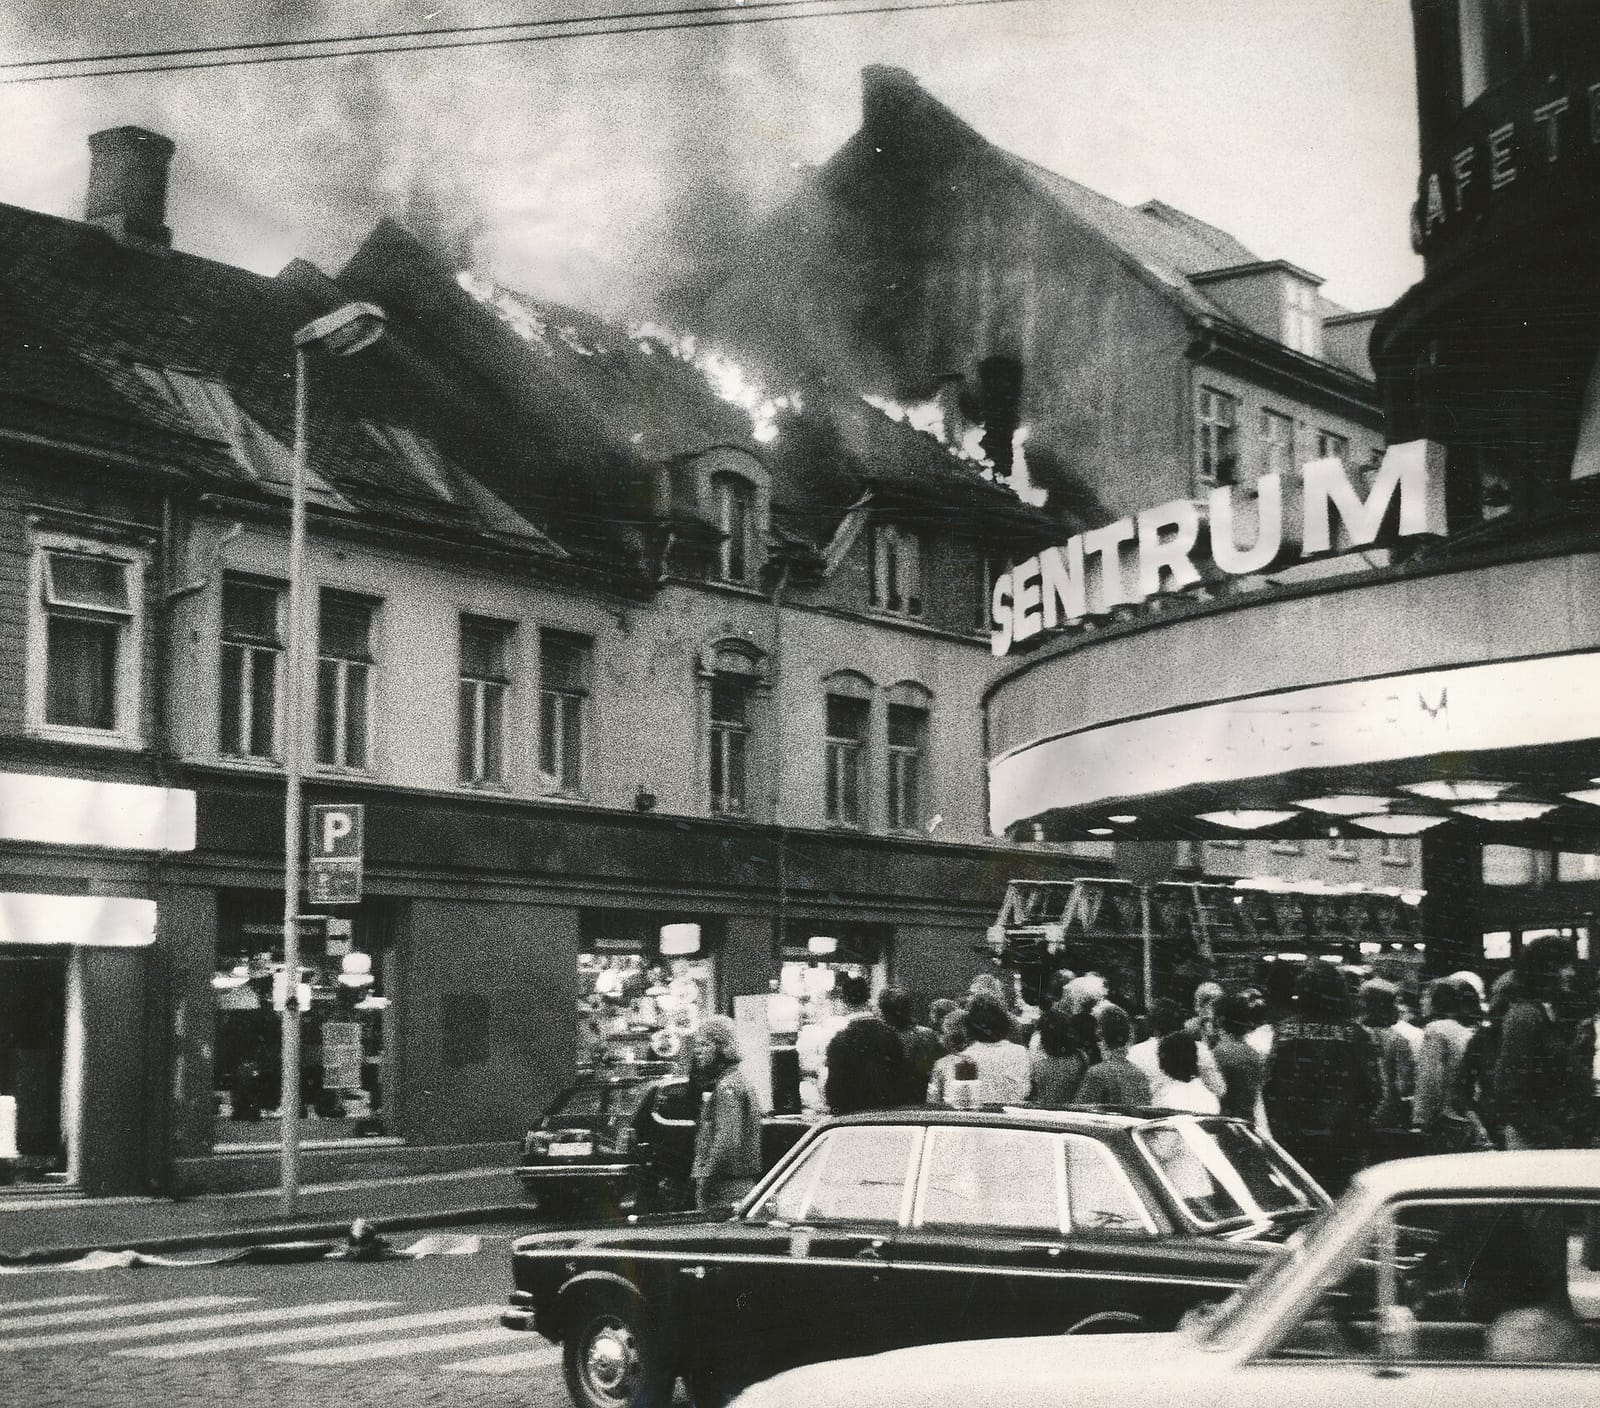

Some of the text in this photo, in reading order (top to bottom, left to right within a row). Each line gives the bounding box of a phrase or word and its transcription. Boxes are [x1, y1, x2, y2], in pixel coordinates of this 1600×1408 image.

[1415, 83, 1600, 247] AFET
[992, 438, 1448, 657] SENTRUM
[324, 812, 352, 852] P
